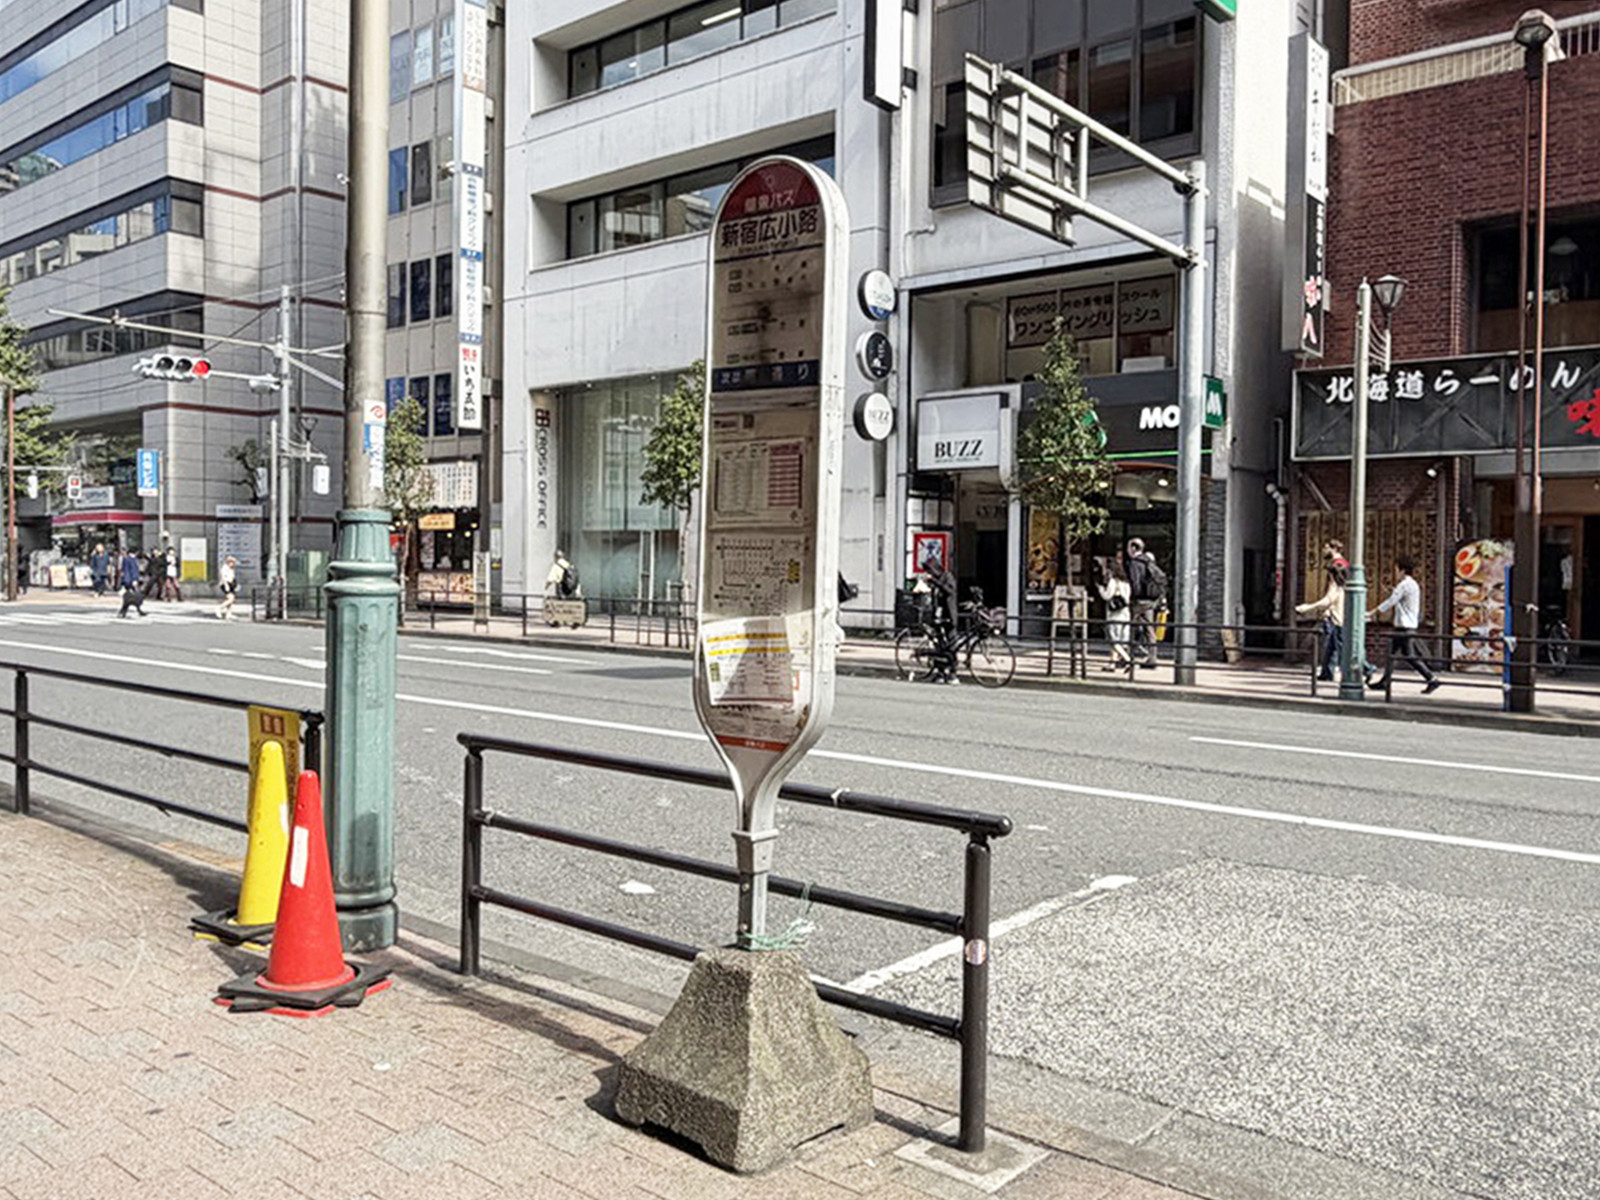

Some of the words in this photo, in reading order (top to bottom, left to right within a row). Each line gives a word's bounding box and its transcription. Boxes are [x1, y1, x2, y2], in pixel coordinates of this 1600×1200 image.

[721, 208, 818, 247] 新宿広小路
[1325, 360, 1582, 404] 北海道らーめん
[1138, 404, 1180, 430] MO
[934, 439, 984, 459] BUZZ
[537, 480, 548, 530] OFFICE
